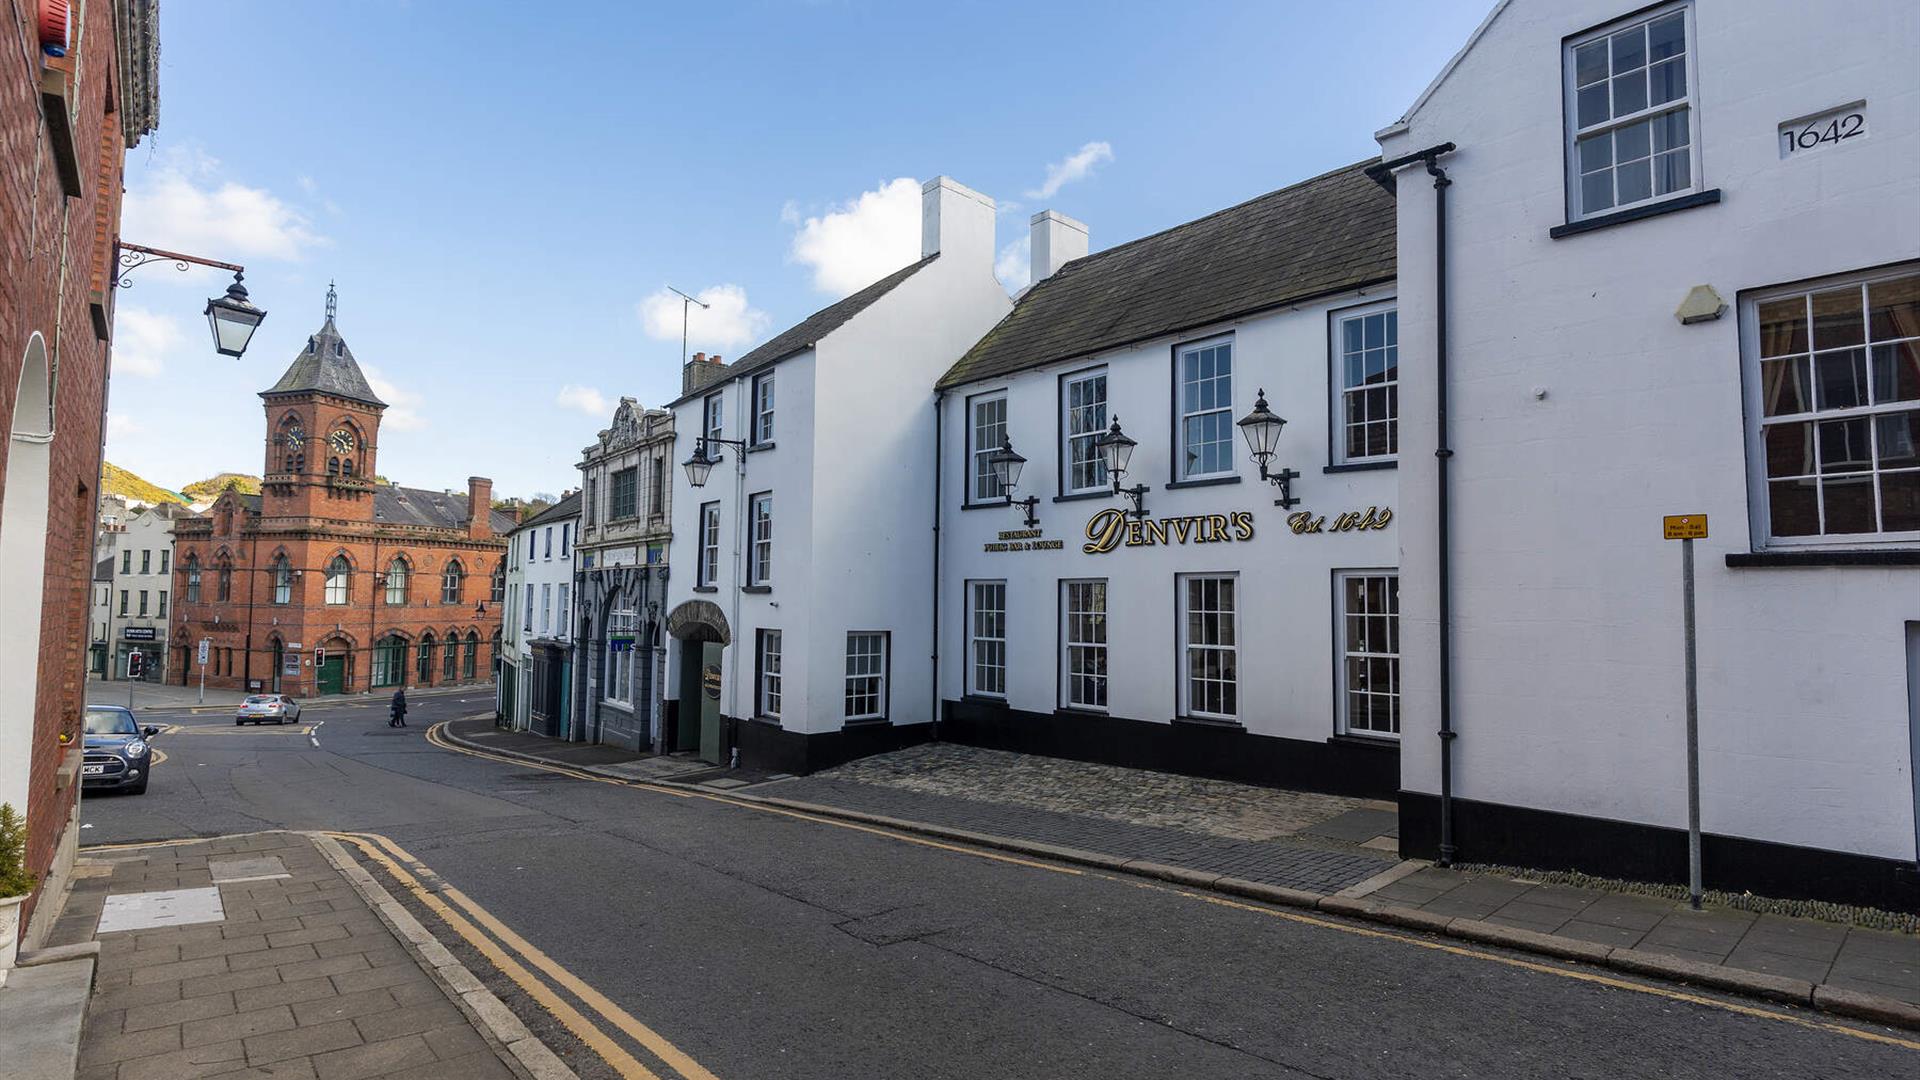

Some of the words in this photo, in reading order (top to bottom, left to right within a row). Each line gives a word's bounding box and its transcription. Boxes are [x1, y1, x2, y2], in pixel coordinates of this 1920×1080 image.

[1783, 114, 1864, 152] 1642
[1287, 510, 1325, 534] Est.
[1328, 506, 1392, 532] 1642
[998, 529, 1042, 540] RESTAURANT
[1032, 540, 1064, 550] LOUNGE
